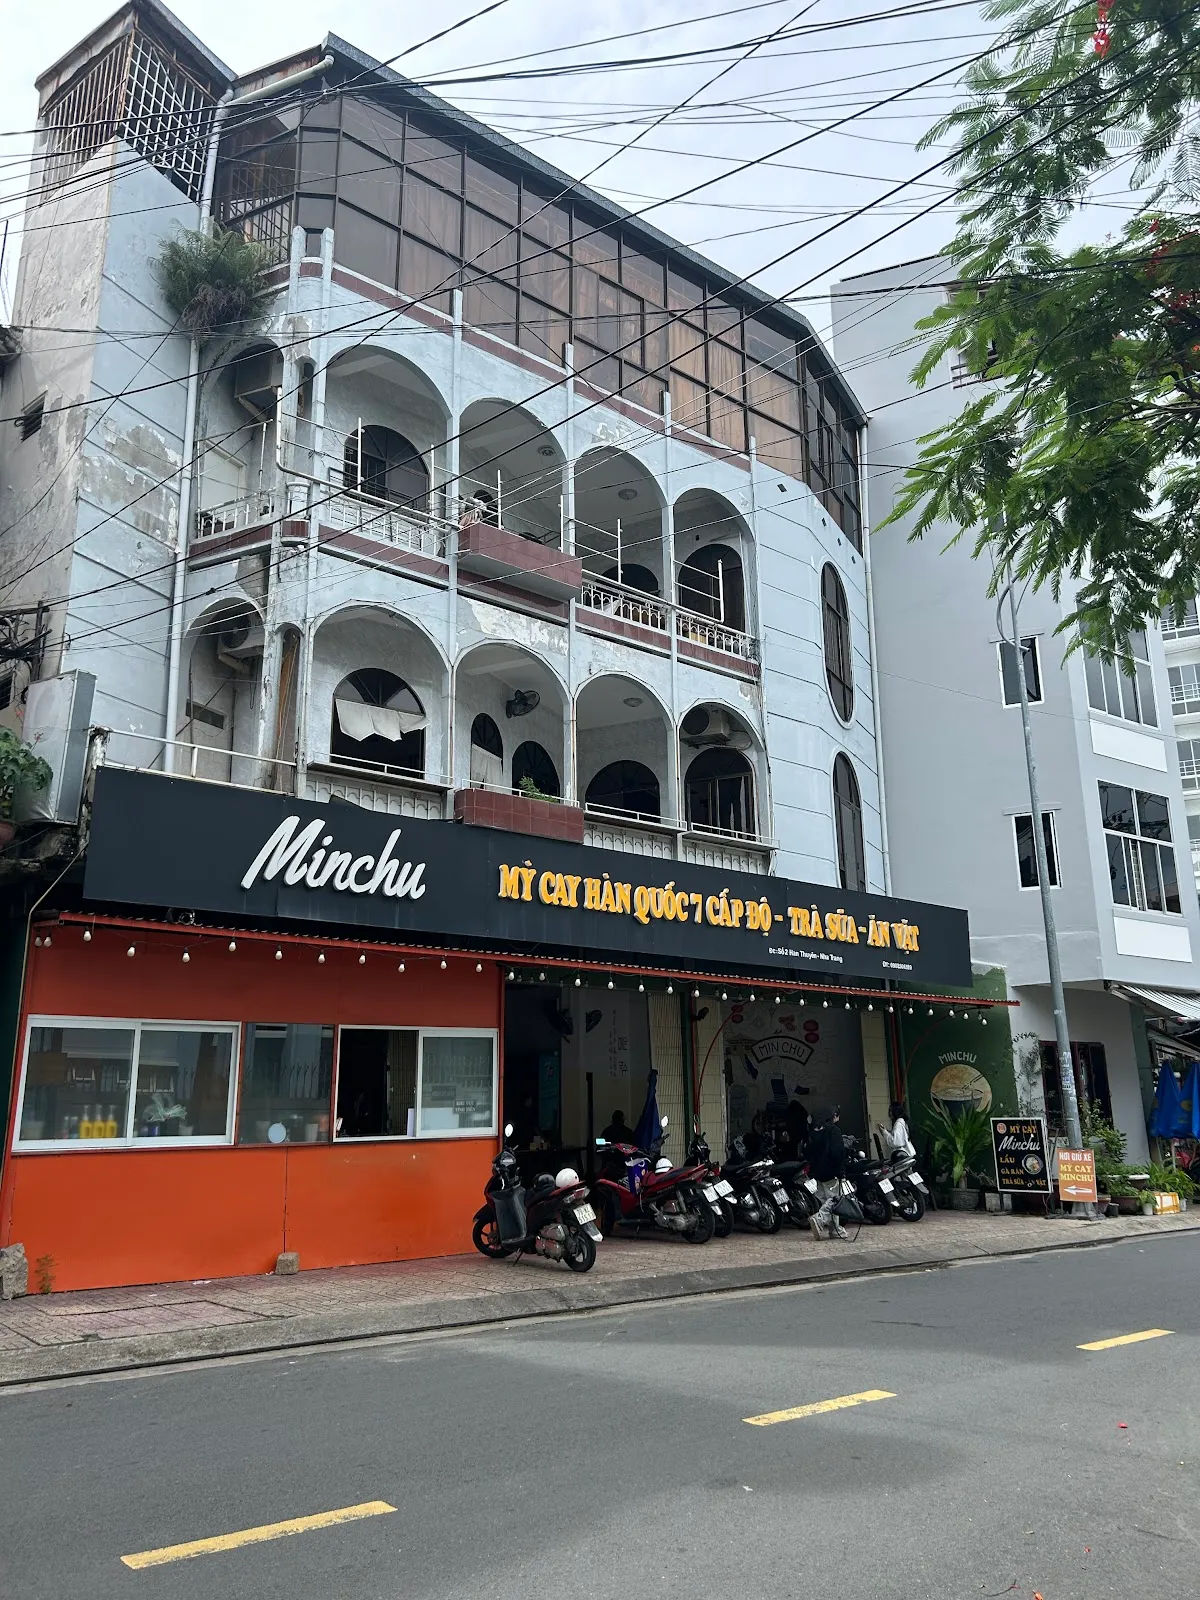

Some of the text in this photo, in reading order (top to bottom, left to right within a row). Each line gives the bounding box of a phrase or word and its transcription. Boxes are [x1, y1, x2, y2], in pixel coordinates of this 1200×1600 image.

[241, 815, 426, 900] Minchu
[538, 871, 581, 908] CAY
[583, 872, 632, 915] HÀN
[633, 881, 689, 925] QUỐC
[690, 893, 703, 924] 7
[705, 888, 744, 928] CẤP
[745, 896, 772, 937] ĐỘ
[787, 904, 824, 939] TRÀ
[825, 908, 859, 944] SỮA
[867, 914, 890, 948] ĂN
[890, 918, 920, 955] VẶT
[830, 953, 843, 964] Trang
[782, 1041, 805, 1058] CHU
[938, 1051, 977, 1064] MINCHU
[1022, 1125, 1037, 1134] CAY
[998, 1134, 1041, 1151] Minchu
[1074, 1165, 1092, 1173] CAY
[1059, 1173, 1094, 1182] MINCHU
